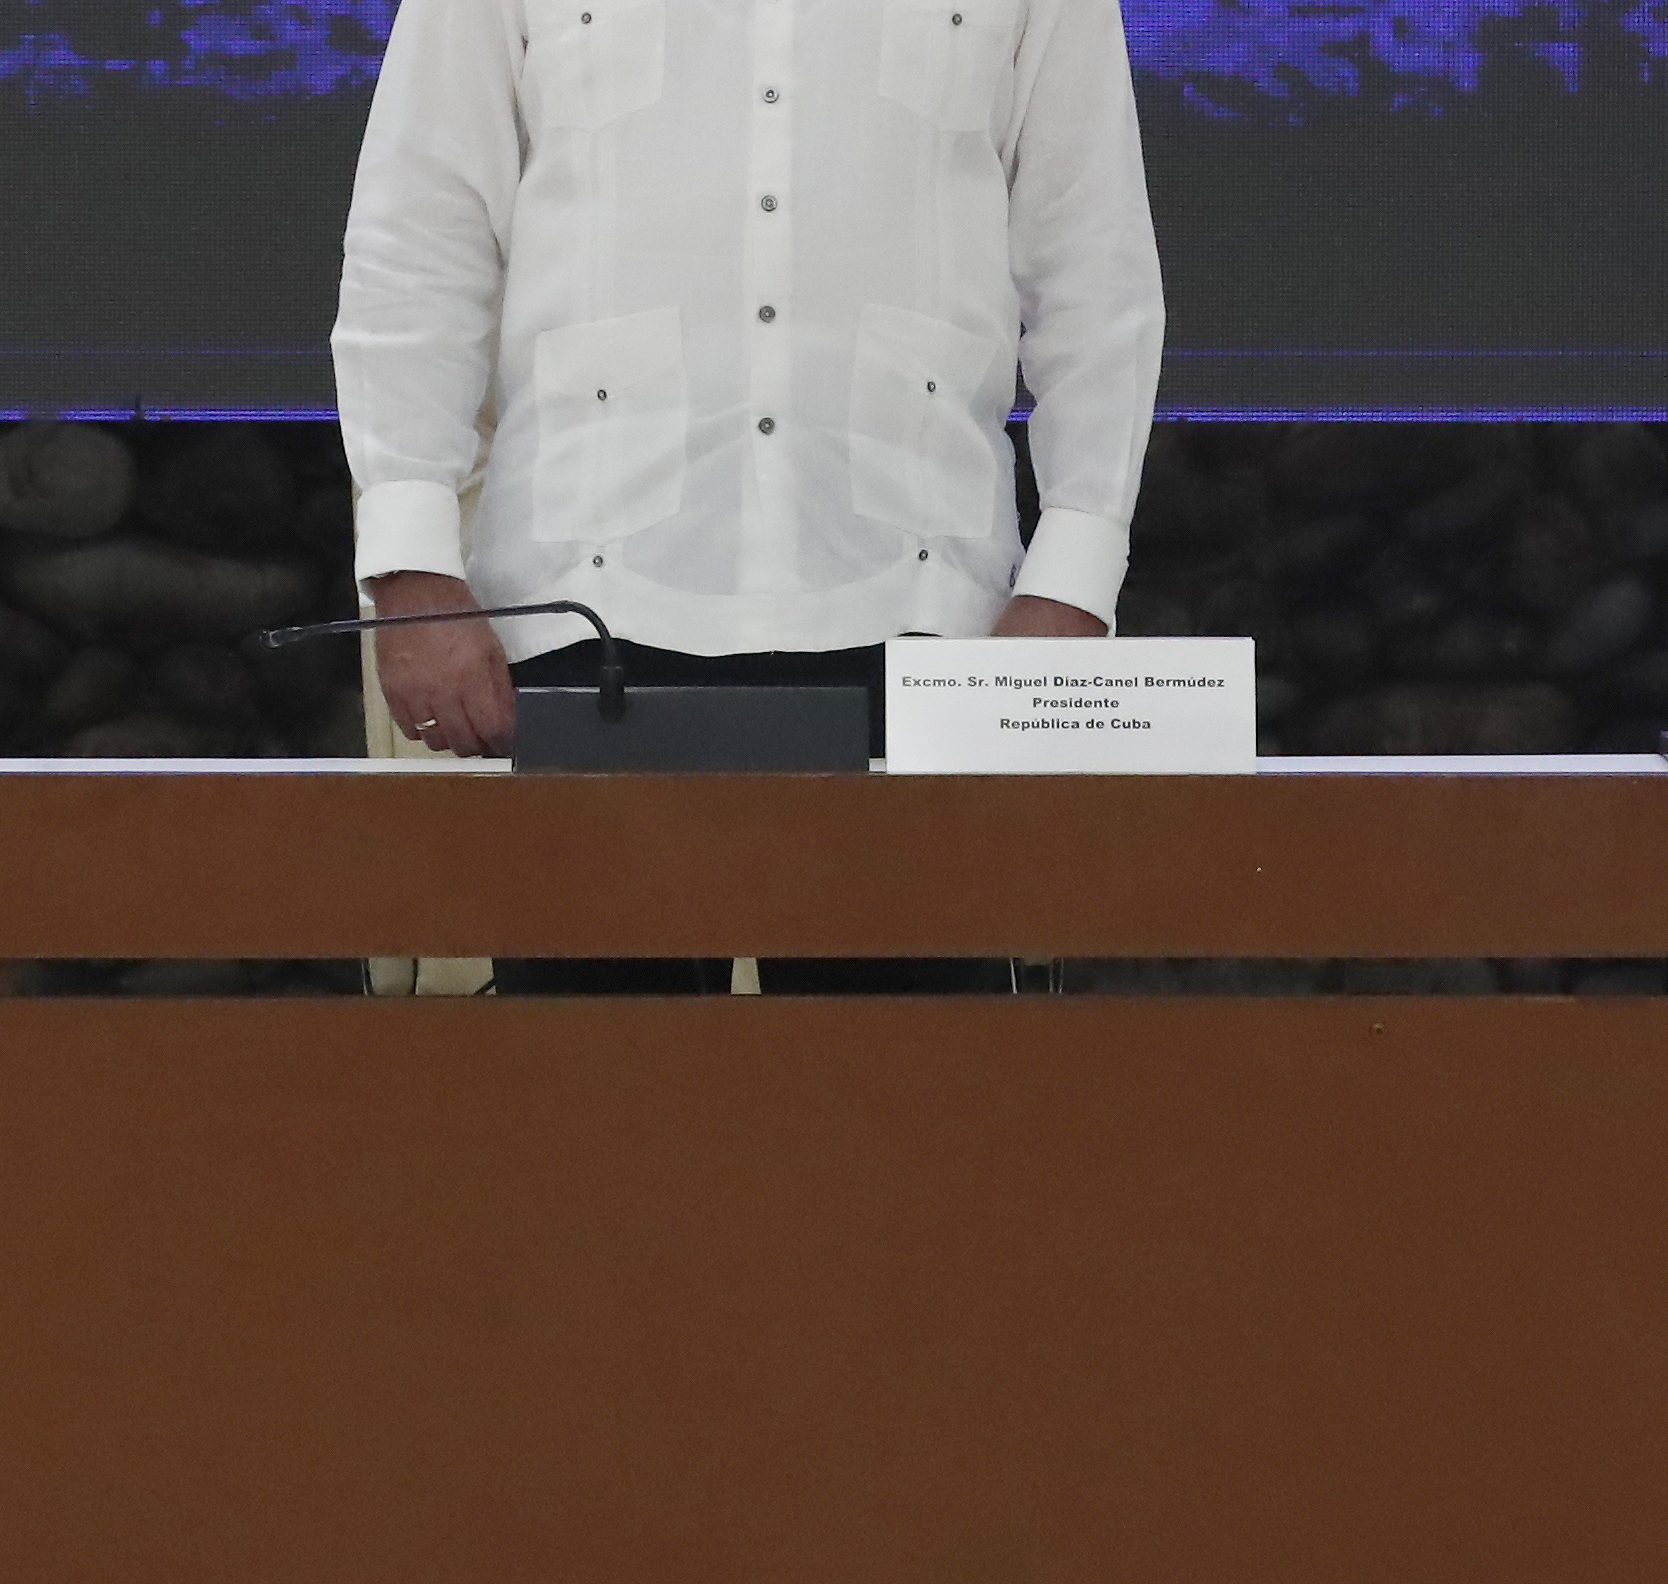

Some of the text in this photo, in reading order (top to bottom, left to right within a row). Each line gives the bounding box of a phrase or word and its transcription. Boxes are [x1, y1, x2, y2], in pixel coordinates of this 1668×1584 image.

[901, 676, 1225, 690] Excmo. Sr. Miguel Díaz-Canel Bermúdez
[1032, 697, 1119, 709] Presidente
[999, 718, 1151, 731] República de Cuba
